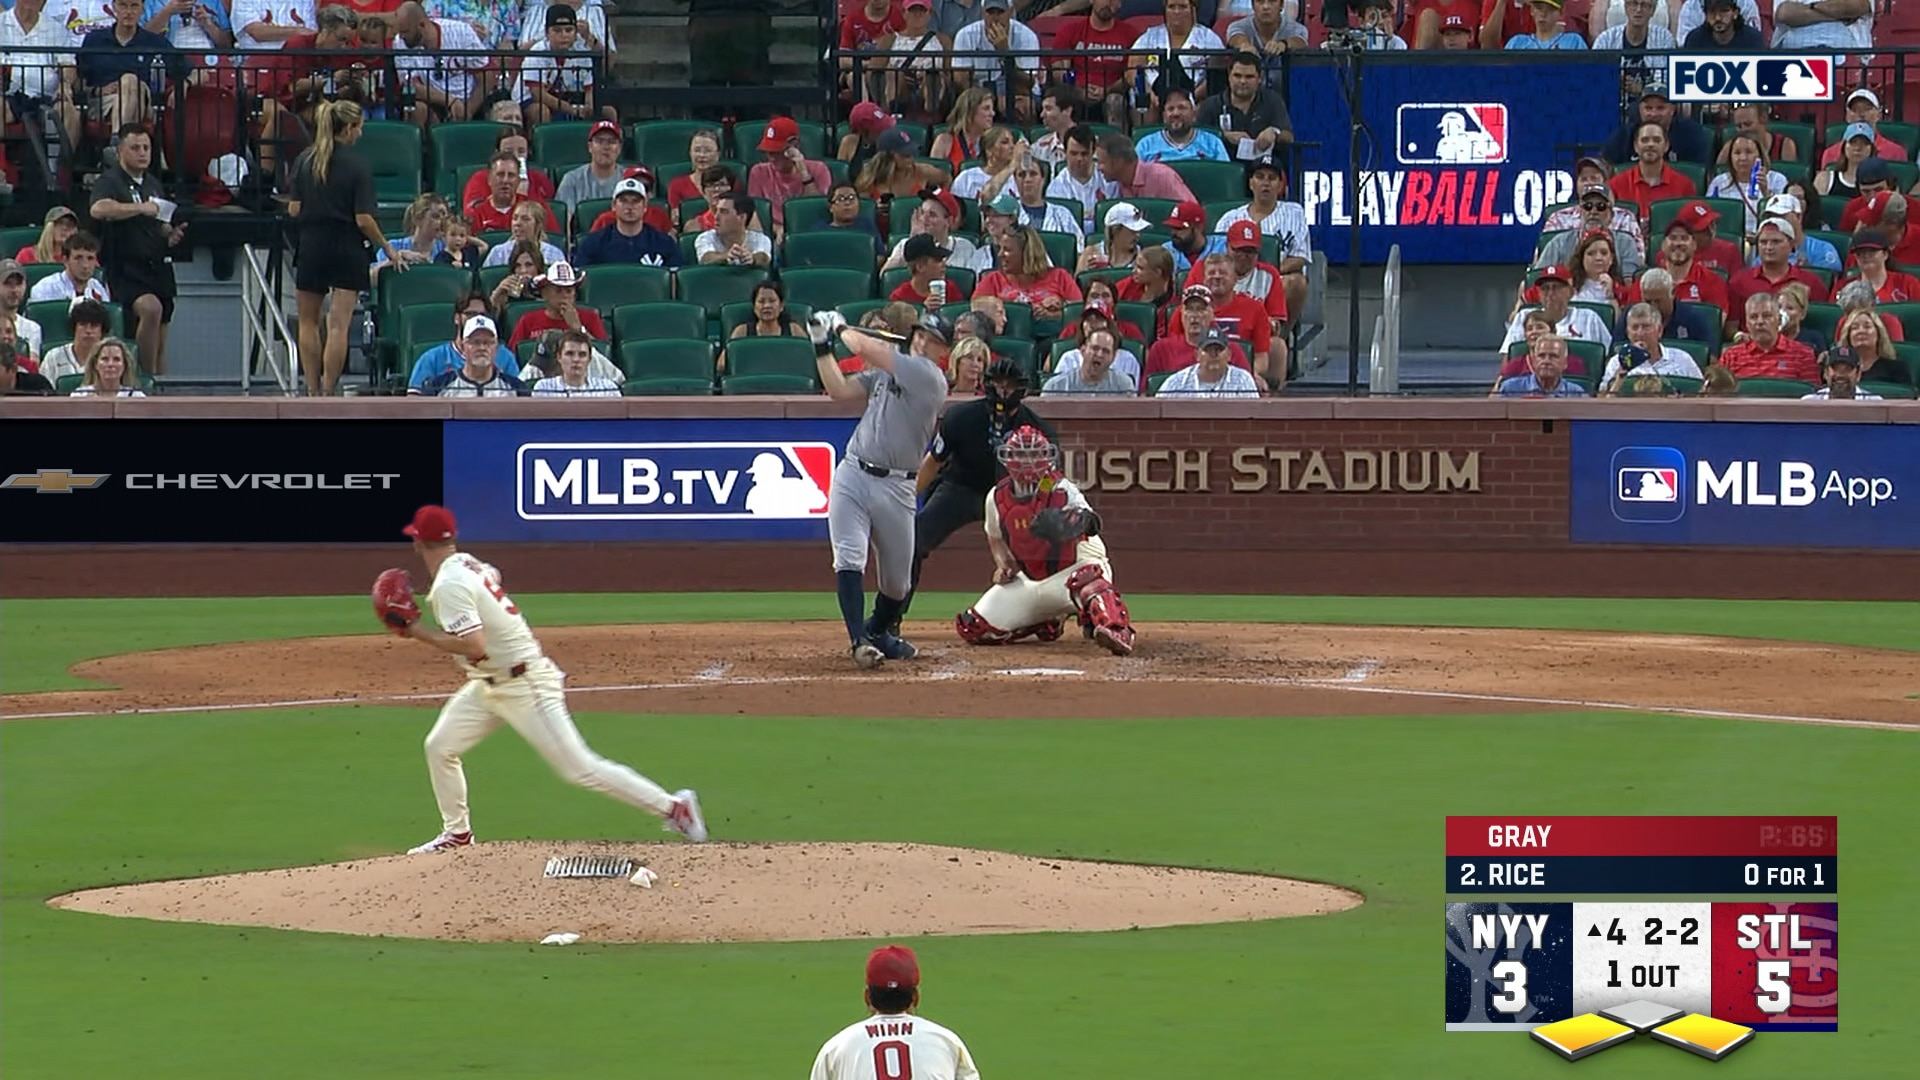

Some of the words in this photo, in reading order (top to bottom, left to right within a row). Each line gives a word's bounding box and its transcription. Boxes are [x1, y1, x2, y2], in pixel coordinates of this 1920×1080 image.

[1445, 15, 1463, 25] STL
[126, 473, 400, 489] CHEVROLET
[534, 458, 738, 506] MLB.TV
[1065, 449, 1210, 492] USCH
[1231, 447, 1480, 492] STADIUM
[1697, 460, 1816, 506] MLB
[865, 1022, 914, 1039] WINN
[873, 1040, 913, 1080] 0
